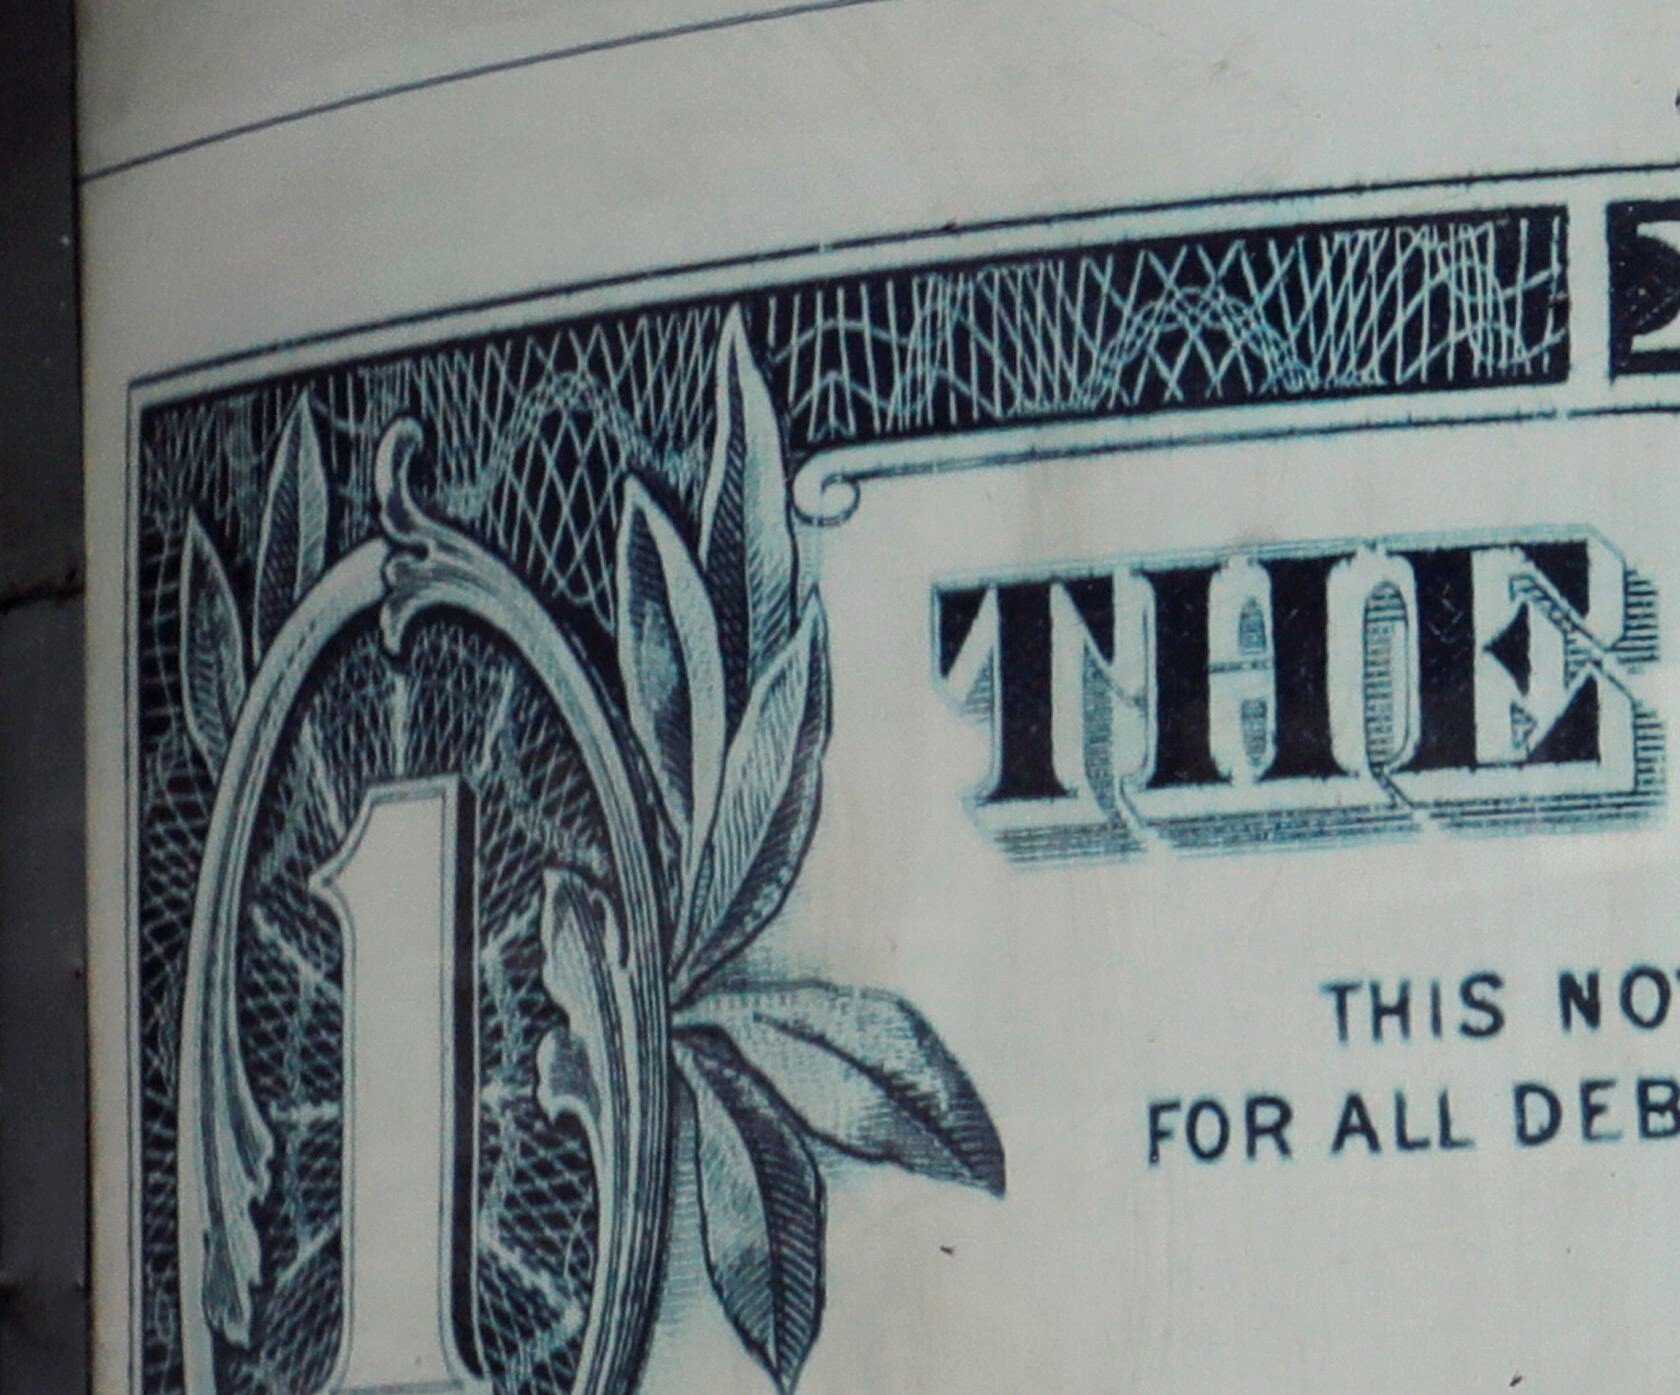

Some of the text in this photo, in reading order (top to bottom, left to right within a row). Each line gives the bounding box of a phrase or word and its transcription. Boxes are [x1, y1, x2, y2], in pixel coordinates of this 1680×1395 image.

[932, 525, 1666, 864] THE
[1320, 974, 1507, 1045] THIS
[1146, 1097, 1294, 1168] FOR
[1329, 1090, 1473, 1158] ALL
